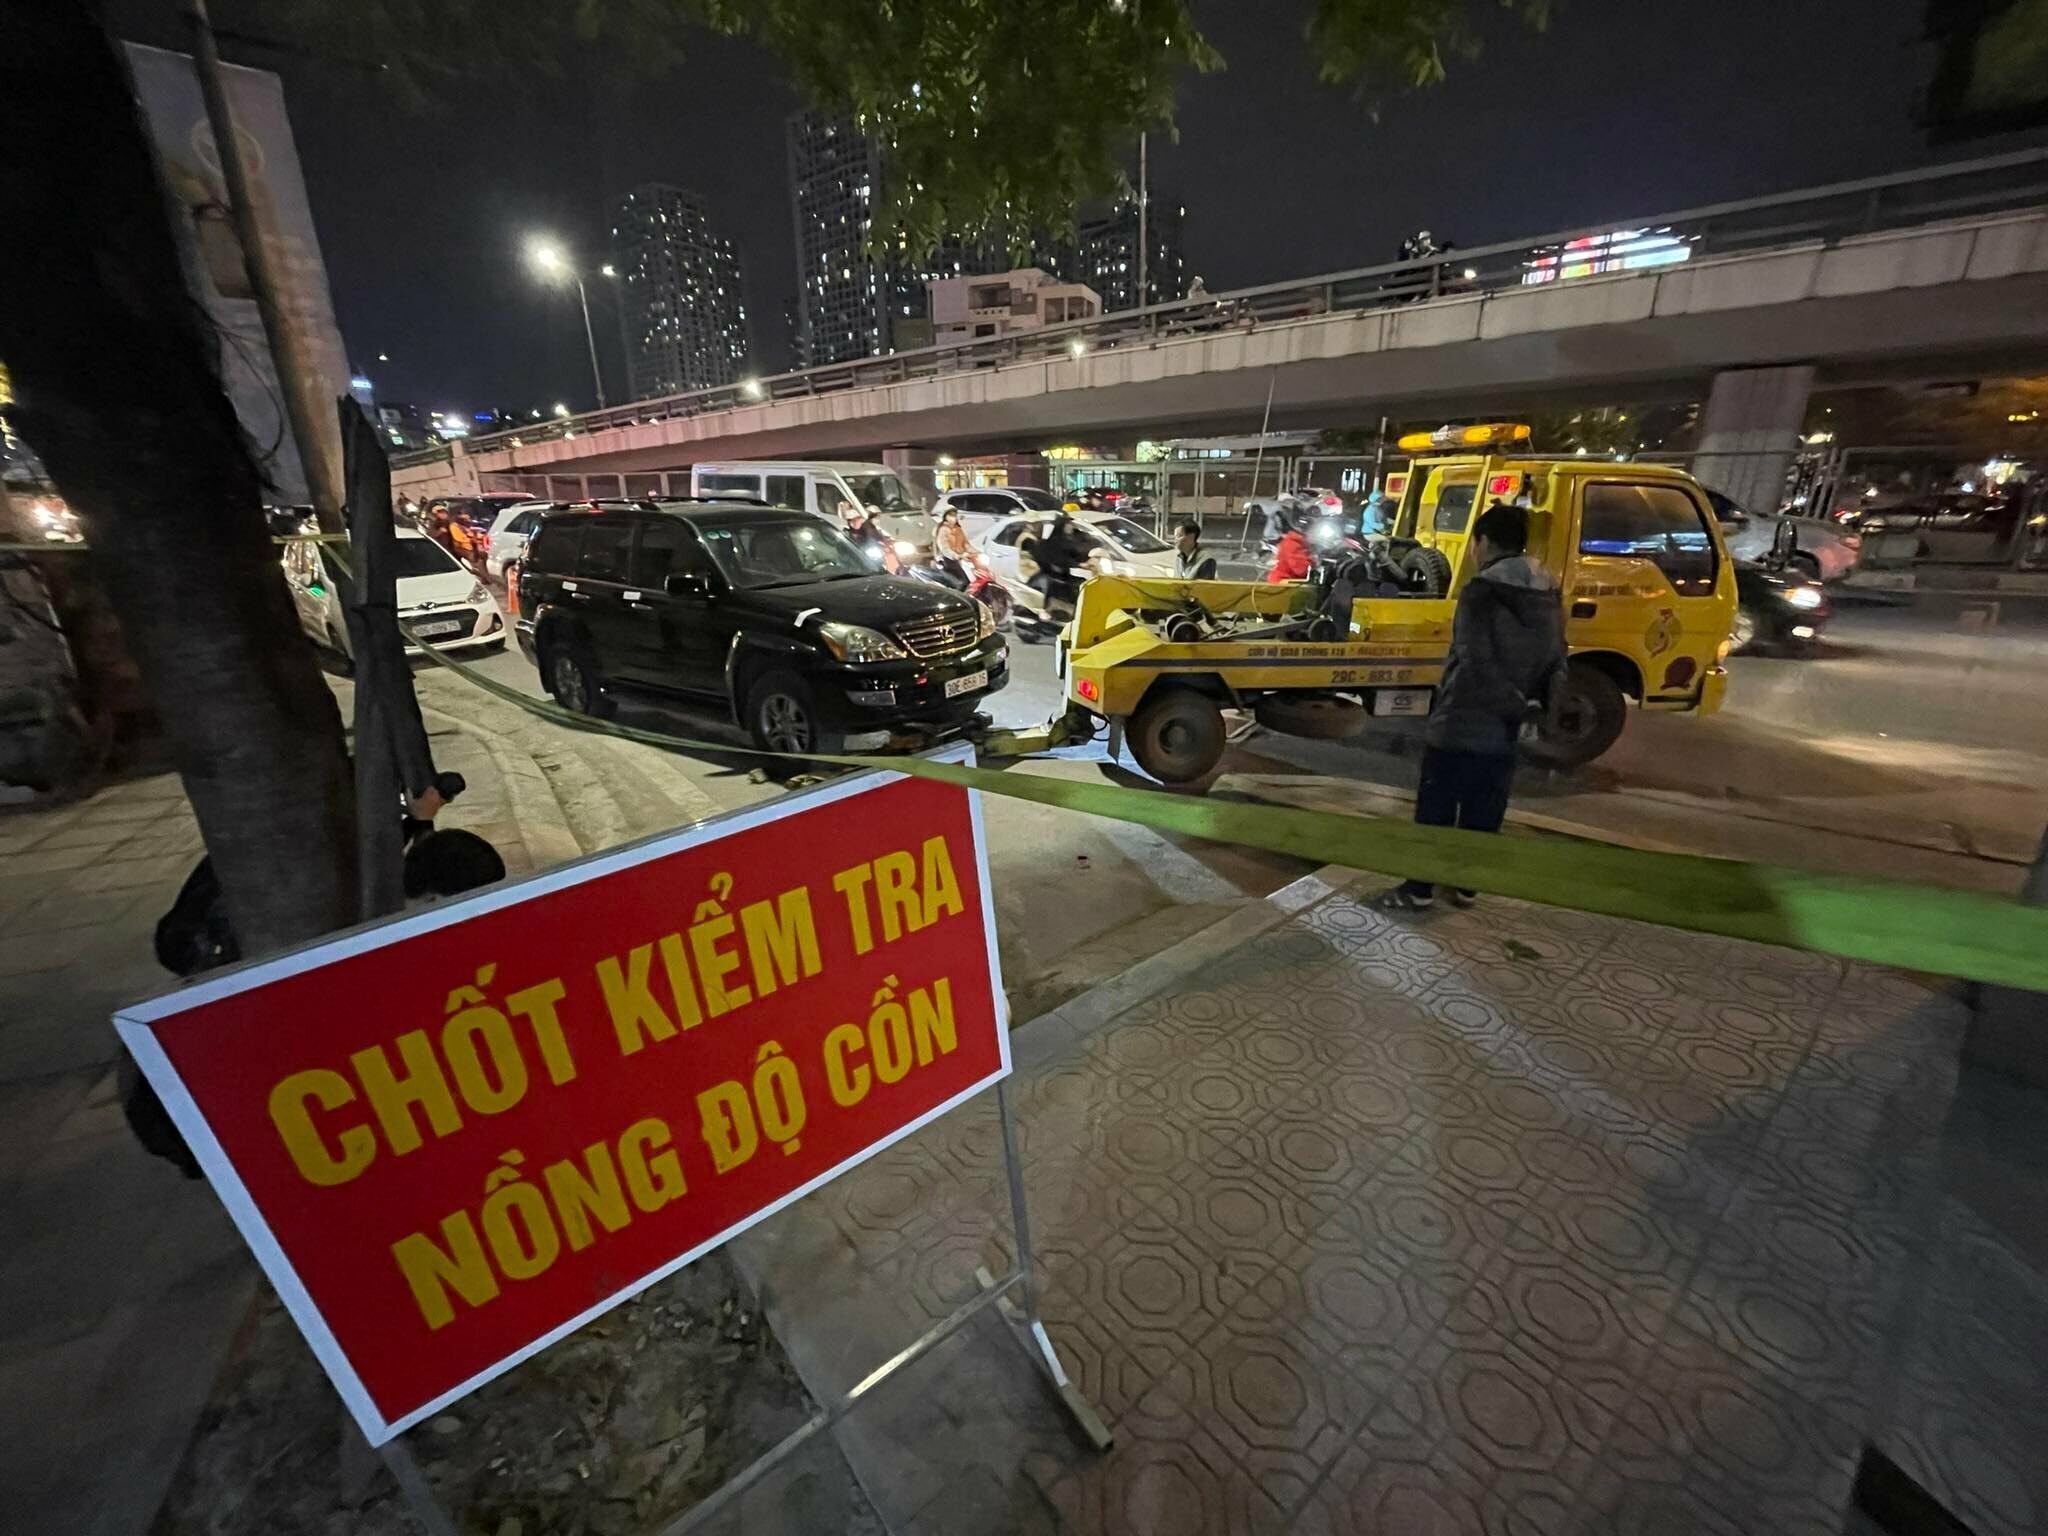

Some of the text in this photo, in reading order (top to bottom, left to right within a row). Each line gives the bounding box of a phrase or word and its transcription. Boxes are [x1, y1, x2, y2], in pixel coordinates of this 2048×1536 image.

[269, 835, 965, 1185] CHỐT KIỂM TRA
[392, 975, 959, 1330] NỒNG ĐỘ CỒN
